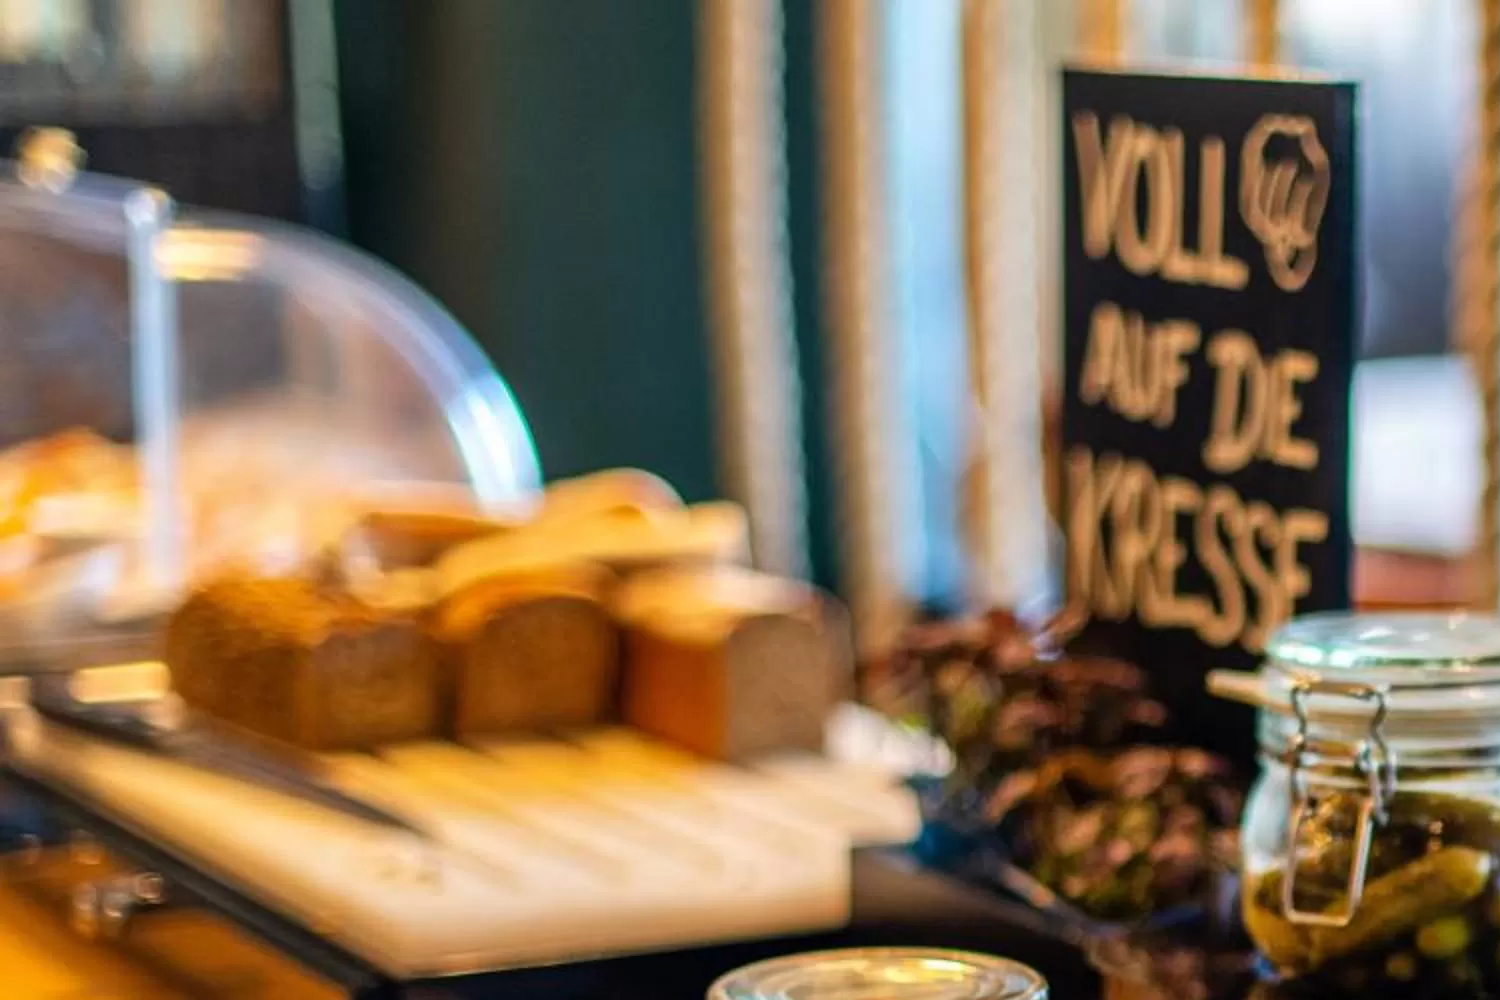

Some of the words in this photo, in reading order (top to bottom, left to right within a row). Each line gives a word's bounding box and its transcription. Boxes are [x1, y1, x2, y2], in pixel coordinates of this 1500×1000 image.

[1073, 110, 1249, 290] VOLL
[1079, 302, 1200, 428] AUF
[1068, 446, 1328, 652] KRESSE
